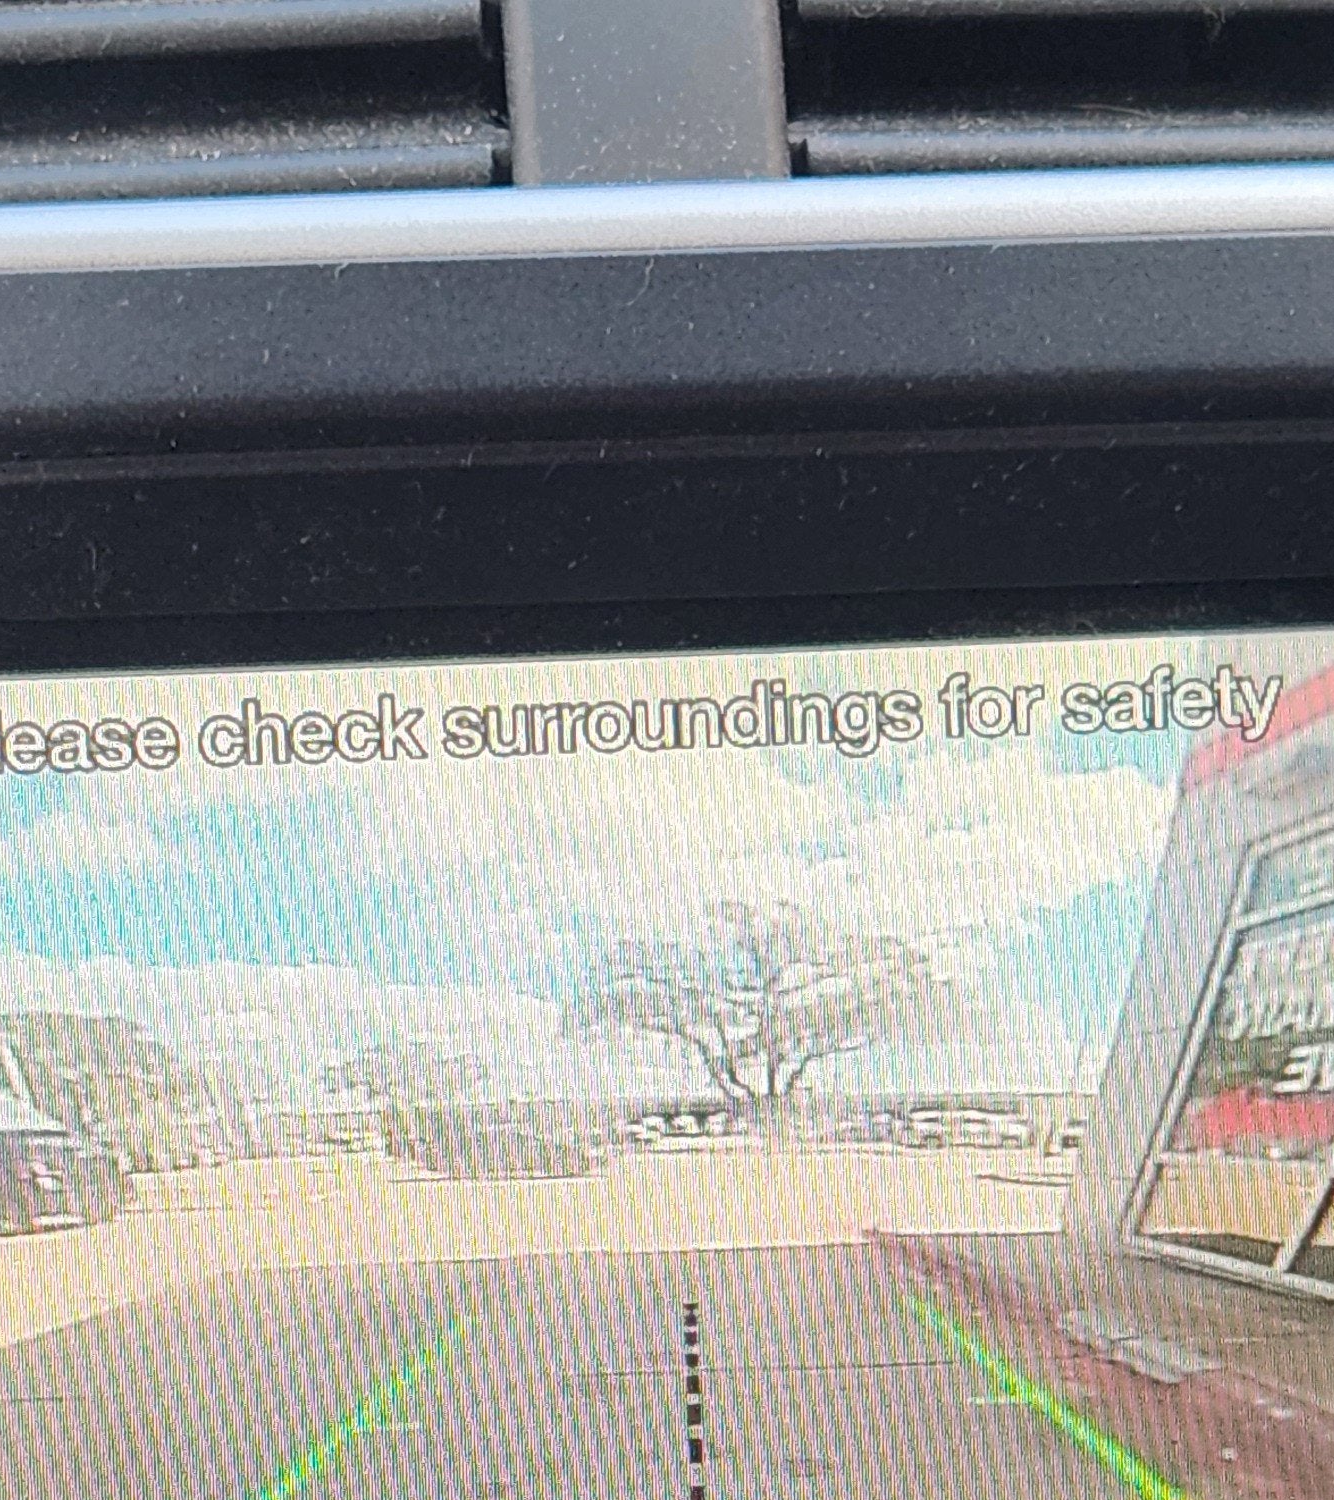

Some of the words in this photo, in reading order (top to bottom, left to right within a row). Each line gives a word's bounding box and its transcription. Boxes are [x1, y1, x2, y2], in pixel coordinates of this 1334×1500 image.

[198, 692, 429, 768] check
[443, 678, 924, 758] surroundings
[939, 671, 1045, 738] for
[1061, 664, 1283, 743] safety
